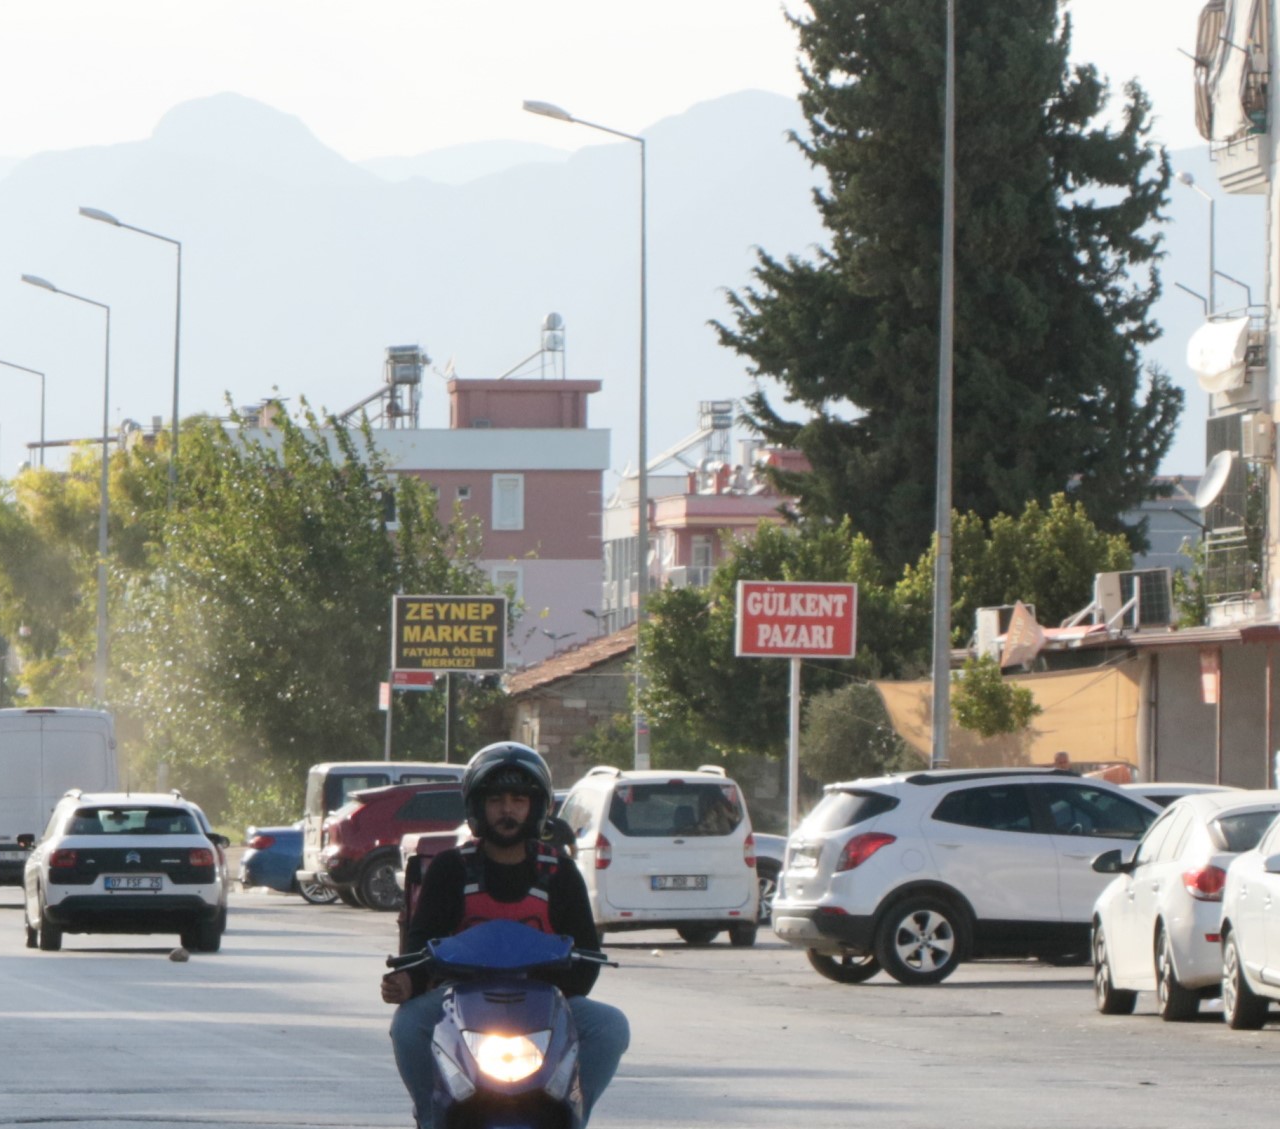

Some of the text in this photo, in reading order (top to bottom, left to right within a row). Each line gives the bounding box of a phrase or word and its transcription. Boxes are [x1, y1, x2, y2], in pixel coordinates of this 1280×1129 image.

[747, 586, 848, 618] GÜLKENT
[405, 603, 495, 620] ZEYNEP
[403, 625, 498, 642] MARKET
[756, 624, 835, 649] PAZARI
[403, 646, 495, 657] FATURA ÖDEME
[421, 656, 476, 668] MERKEZİ
